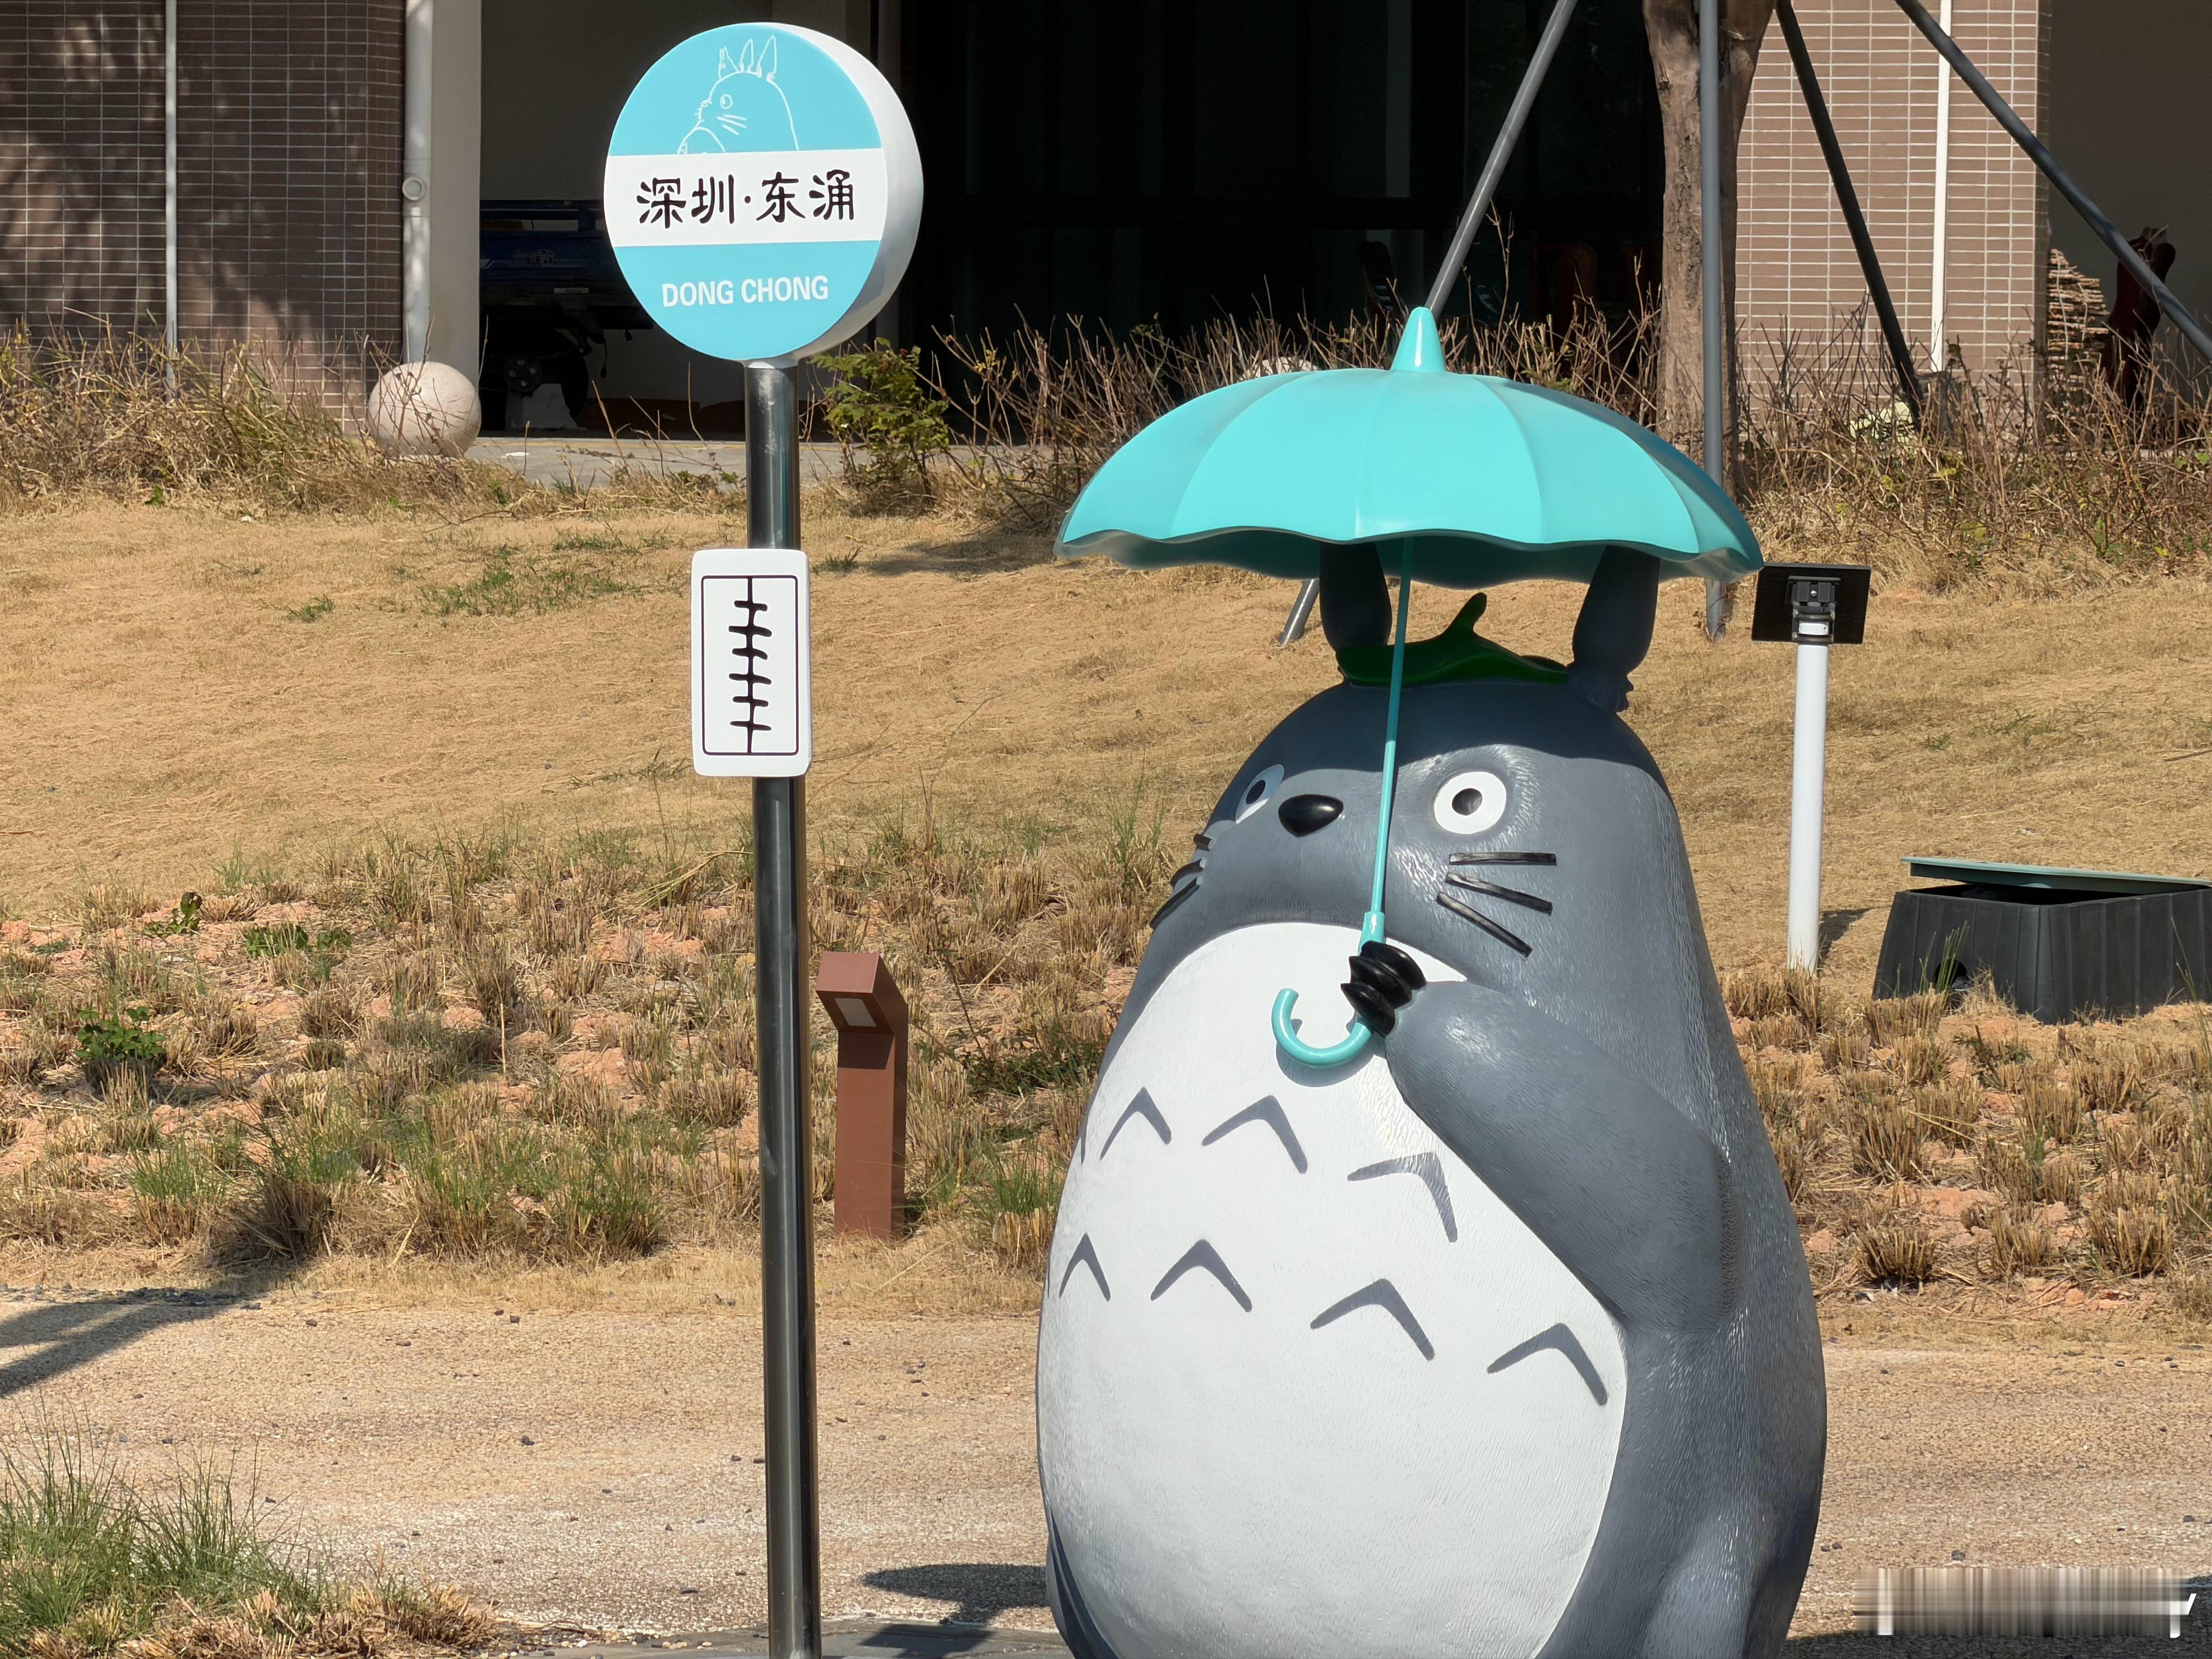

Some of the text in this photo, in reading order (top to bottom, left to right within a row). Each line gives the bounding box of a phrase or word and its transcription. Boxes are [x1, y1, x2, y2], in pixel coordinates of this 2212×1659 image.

[636, 169, 854, 229] 深圳·东涌
[662, 275, 828, 307] DONG CHONG
